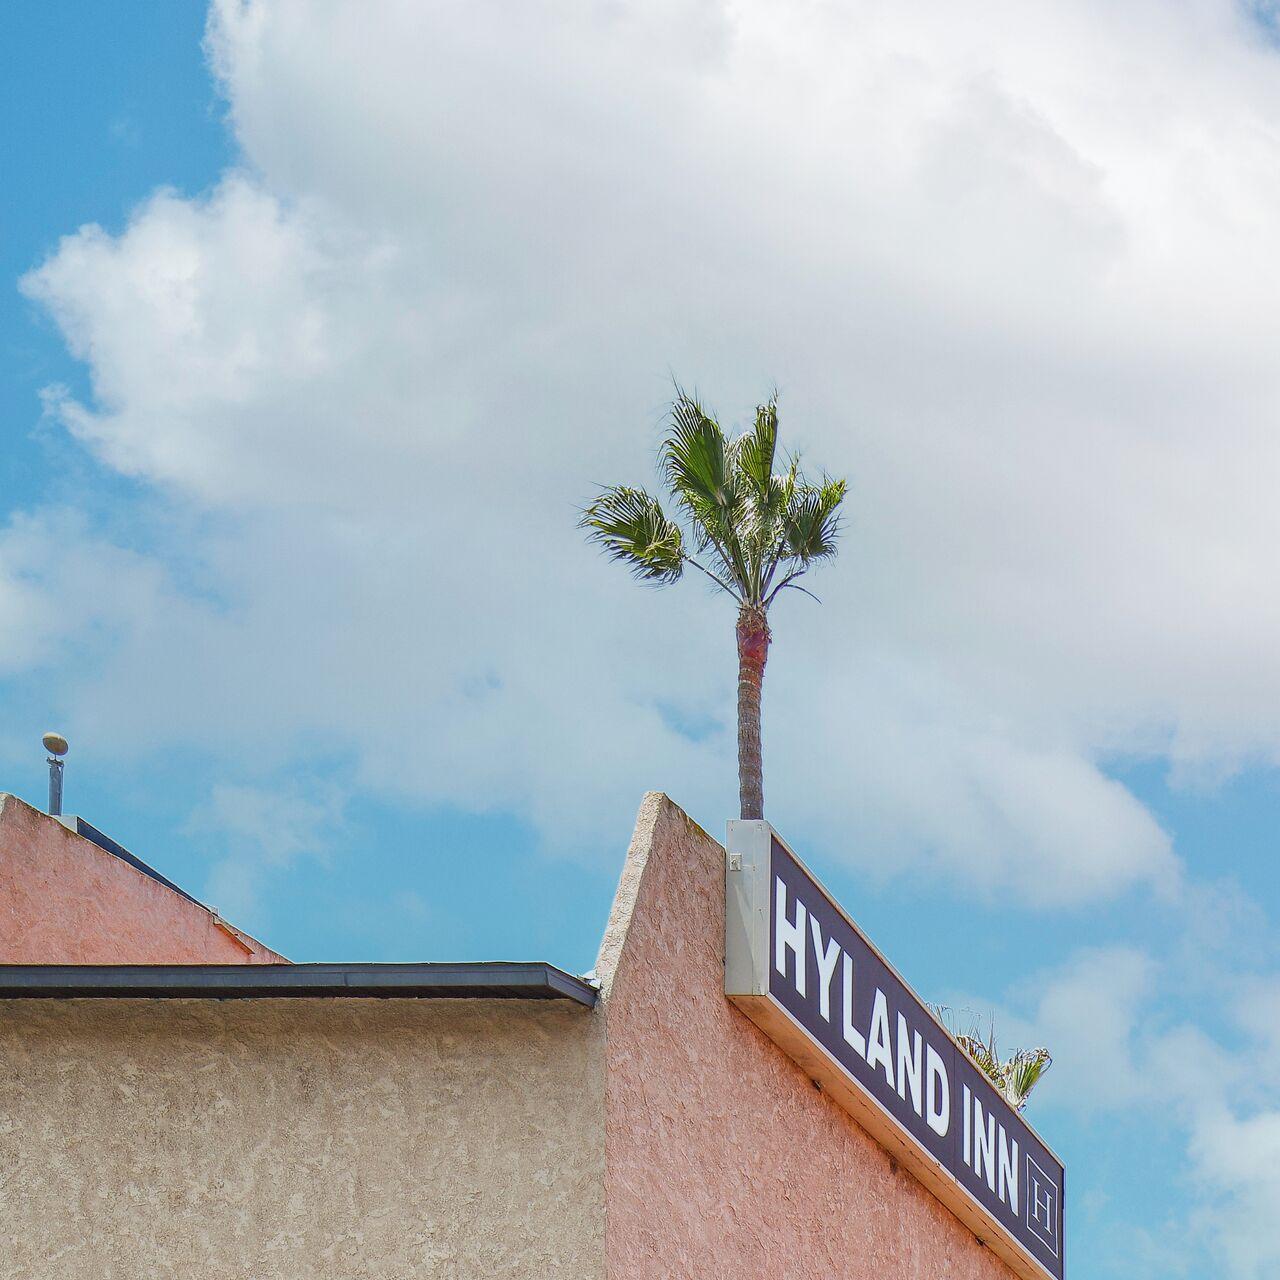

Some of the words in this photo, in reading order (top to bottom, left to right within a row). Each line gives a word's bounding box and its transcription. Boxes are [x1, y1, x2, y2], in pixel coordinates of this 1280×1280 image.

[776, 874, 950, 1137] HYLAND
[963, 1083, 1018, 1217] INN
[1032, 1176, 1053, 1235] H
